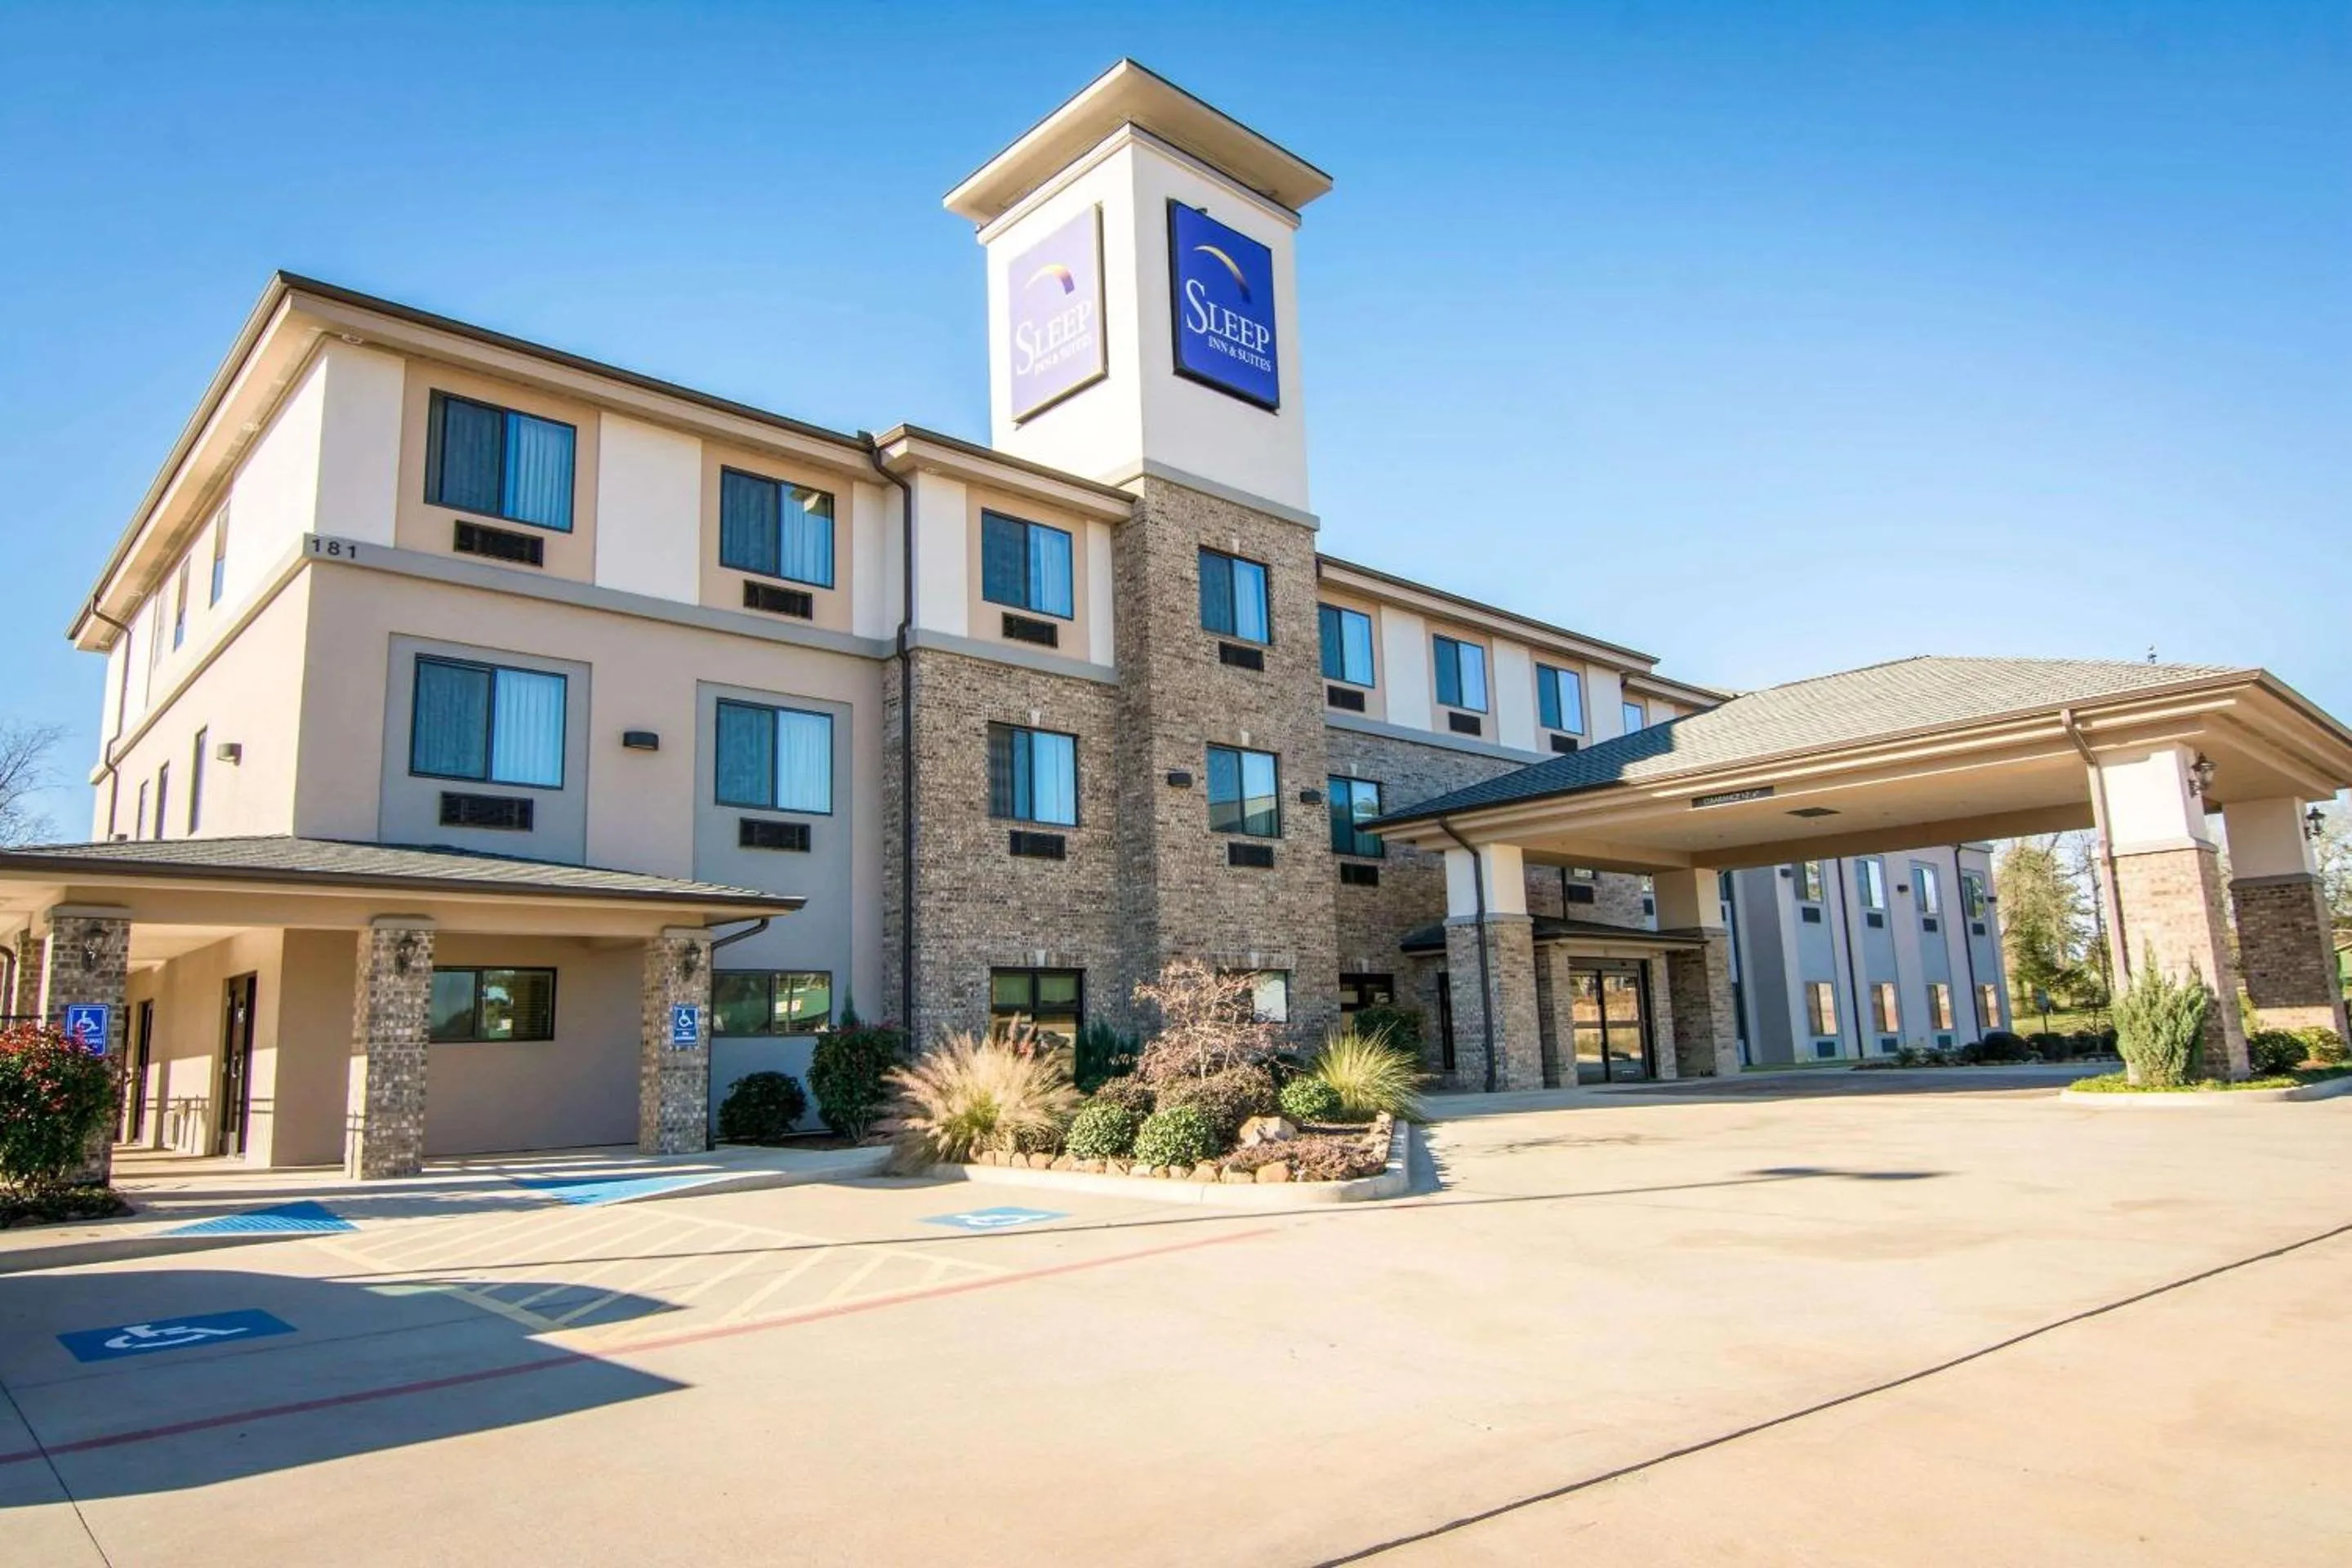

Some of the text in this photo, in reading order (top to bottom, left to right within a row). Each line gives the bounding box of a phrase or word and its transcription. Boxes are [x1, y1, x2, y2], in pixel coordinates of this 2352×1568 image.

[1016, 301, 1092, 376] SLEEP
[1186, 278, 1270, 354] SLEEP
[1209, 335, 1272, 372] INN & SUITES
[312, 538, 356, 559] 181
